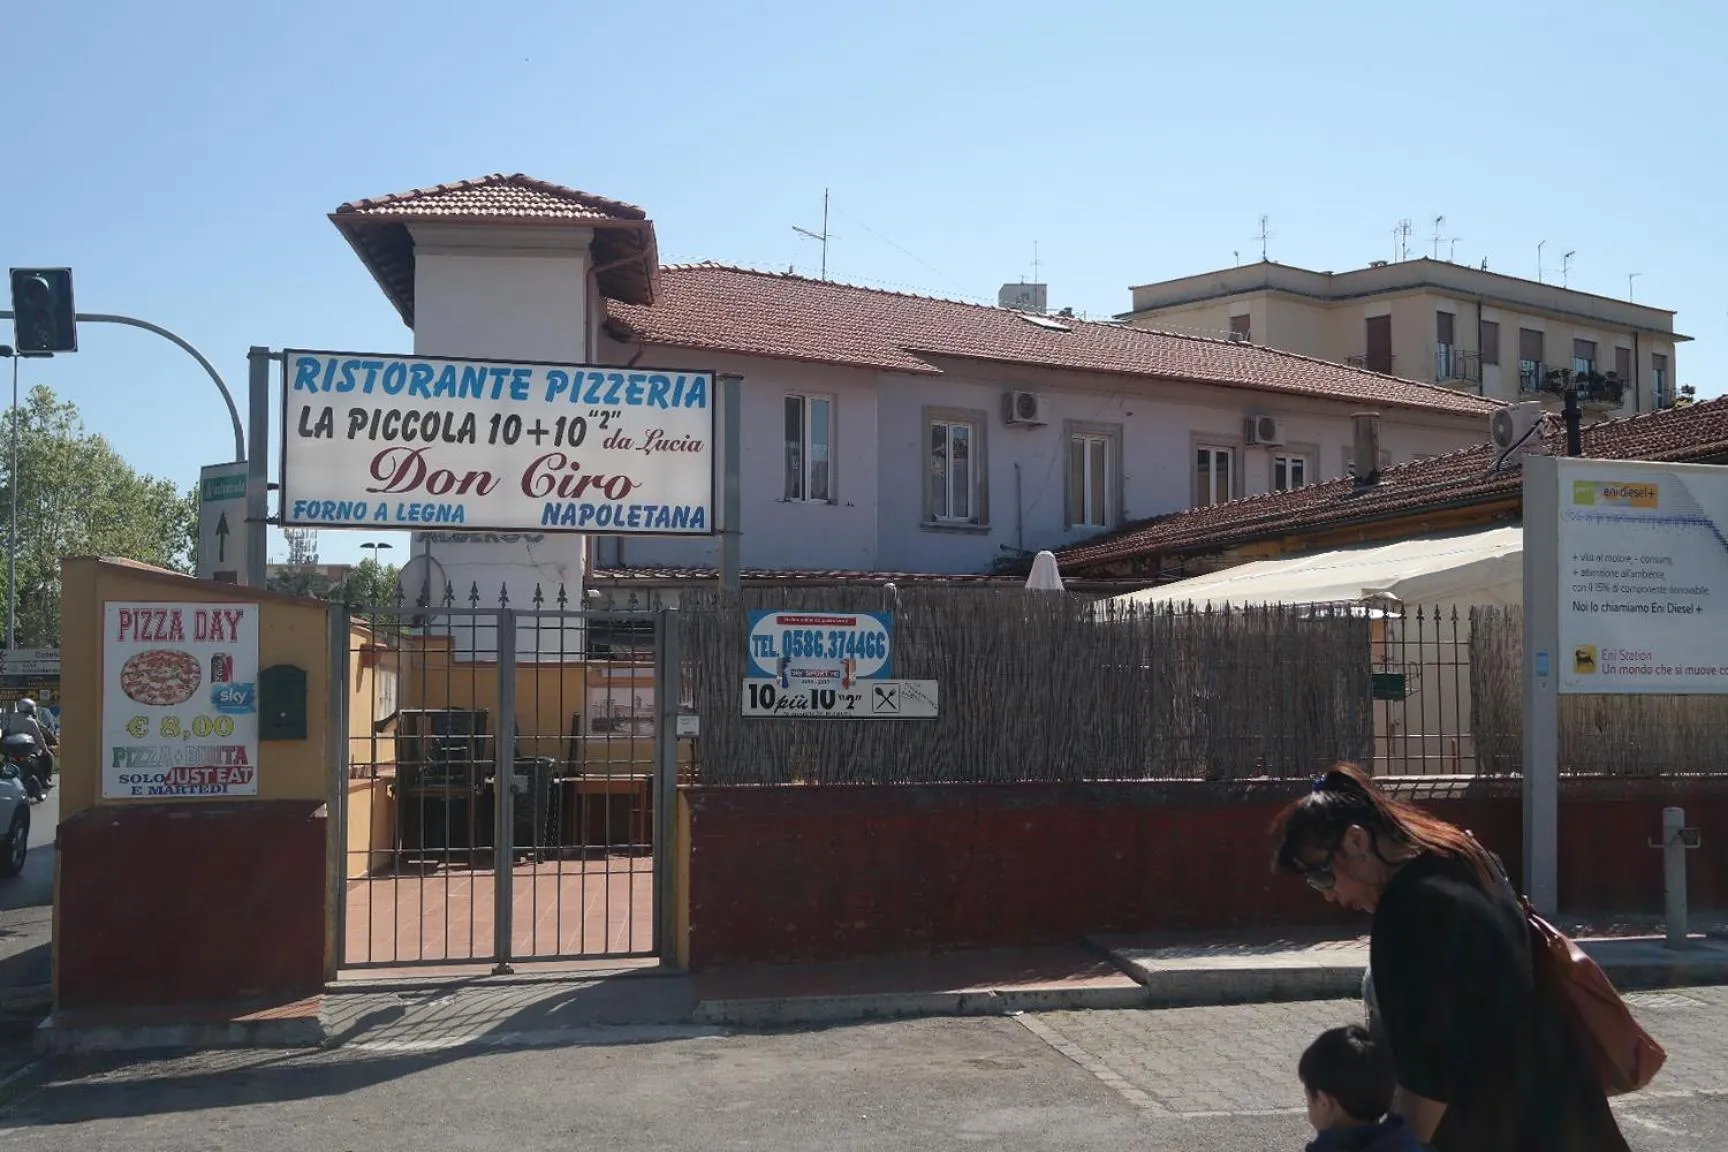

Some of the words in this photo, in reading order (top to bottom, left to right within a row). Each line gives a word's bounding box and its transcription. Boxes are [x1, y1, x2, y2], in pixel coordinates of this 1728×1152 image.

[293, 358, 532, 401] RISTORANTE
[545, 370, 708, 409] PIZZERIA
[298, 405, 335, 438] LA
[347, 408, 477, 444] PICCOLA
[603, 427, 633, 451] da
[634, 429, 704, 455] Lucia
[365, 446, 500, 496] Don
[520, 452, 641, 500] Ciro
[293, 500, 367, 521] FORNO
[373, 502, 388, 521] A
[396, 502, 465, 523] LEGNA
[541, 502, 706, 529] NAPOLETANA
[1572, 601, 1588, 612] Noi
[1590, 601, 1598, 613] lo
[1601, 602, 1649, 613] chiamiamo
[1651, 602, 1665, 613] Eni
[1667, 603, 1694, 614] Diesel
[117, 608, 185, 642] PIZZA
[193, 609, 244, 643] DAY
[752, 634, 780, 657] TEL.
[782, 629, 886, 659] 0586.374466
[1601, 649, 1616, 661] Eni
[1620, 649, 1653, 661] Station
[1602, 663, 1617, 675] Un
[1620, 665, 1653, 675] mondo
[1655, 664, 1672, 675] che
[1675, 664, 1682, 675] si
[1685, 665, 1717, 676] muove
[220, 688, 248, 705] sky
[748, 683, 776, 709] 10
[774, 694, 809, 714] più
[809, 688, 836, 710] 10
[126, 715, 150, 738] €
[160, 715, 235, 740] 8,00
[112, 746, 173, 768] PIZZA
[119, 773, 166, 784] SOLO
[166, 768, 214, 784] JUST
[217, 766, 254, 783] EAT
[131, 786, 142, 796] E
